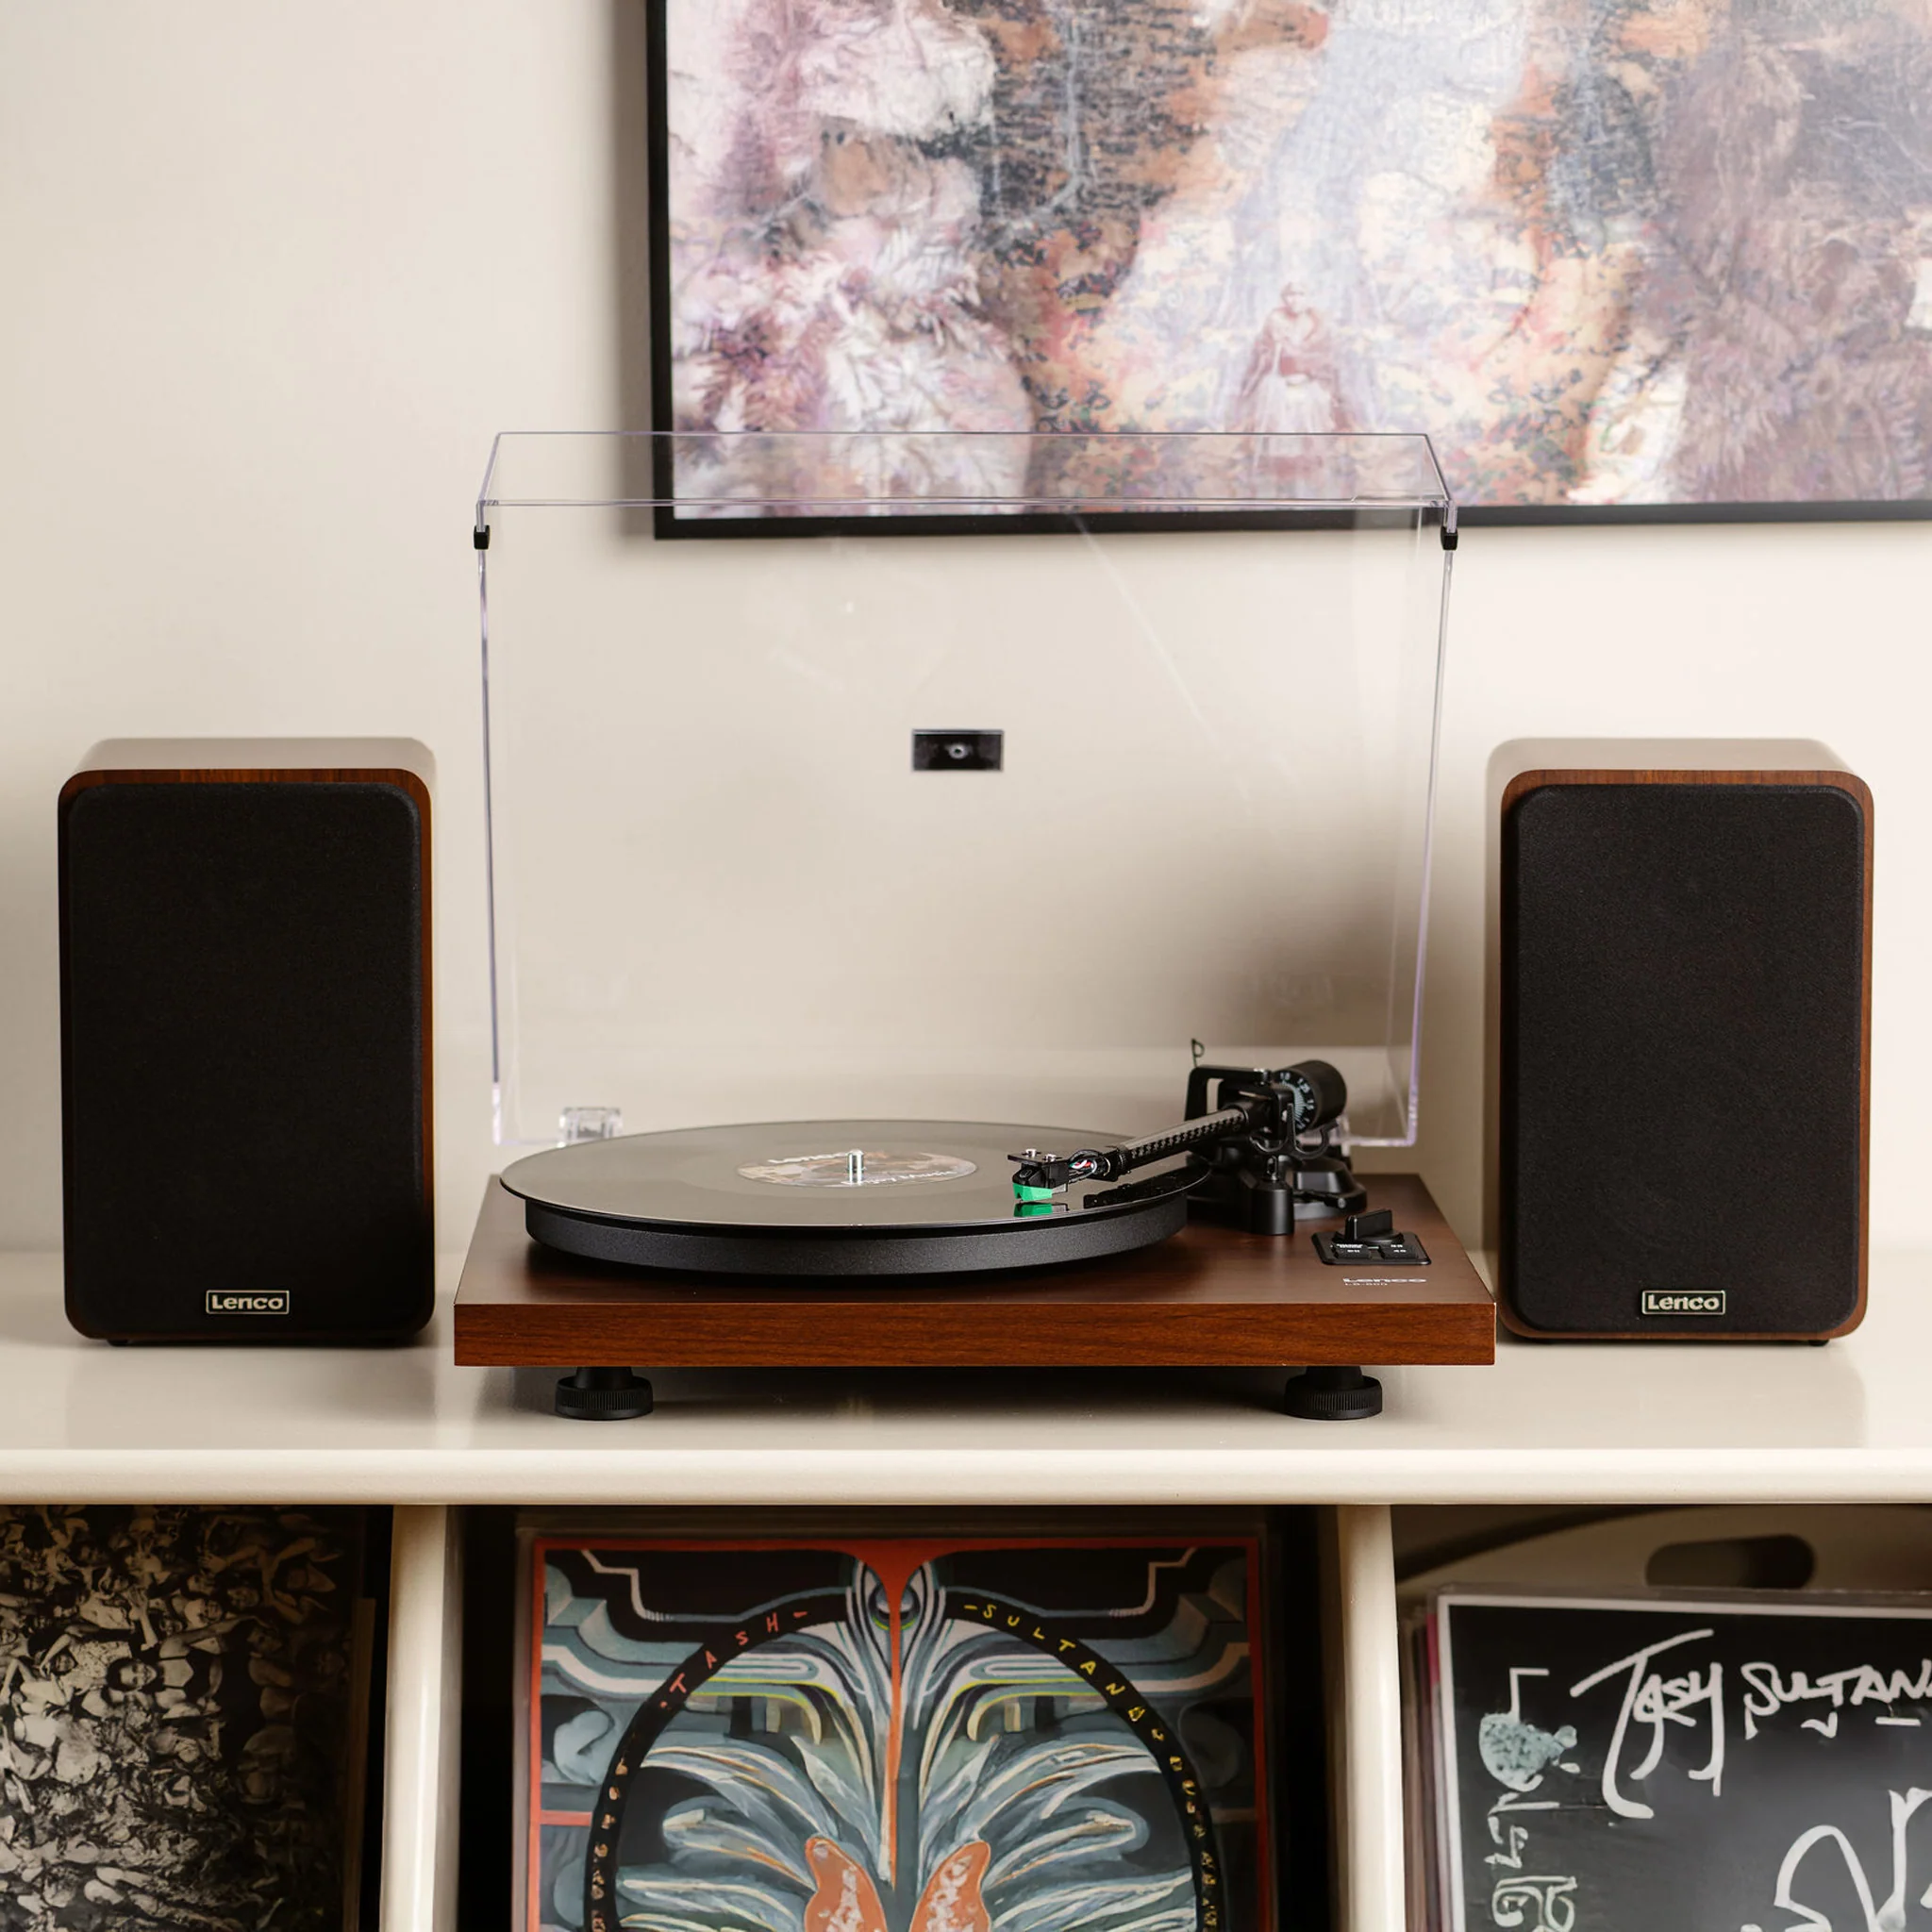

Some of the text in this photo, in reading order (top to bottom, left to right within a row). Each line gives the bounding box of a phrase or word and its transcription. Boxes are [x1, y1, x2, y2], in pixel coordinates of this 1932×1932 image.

[211, 1294, 284, 1310] Lenco
[1647, 1293, 1720, 1310] Lenco
[1740, 1657, 1932, 1717] SULTAN
